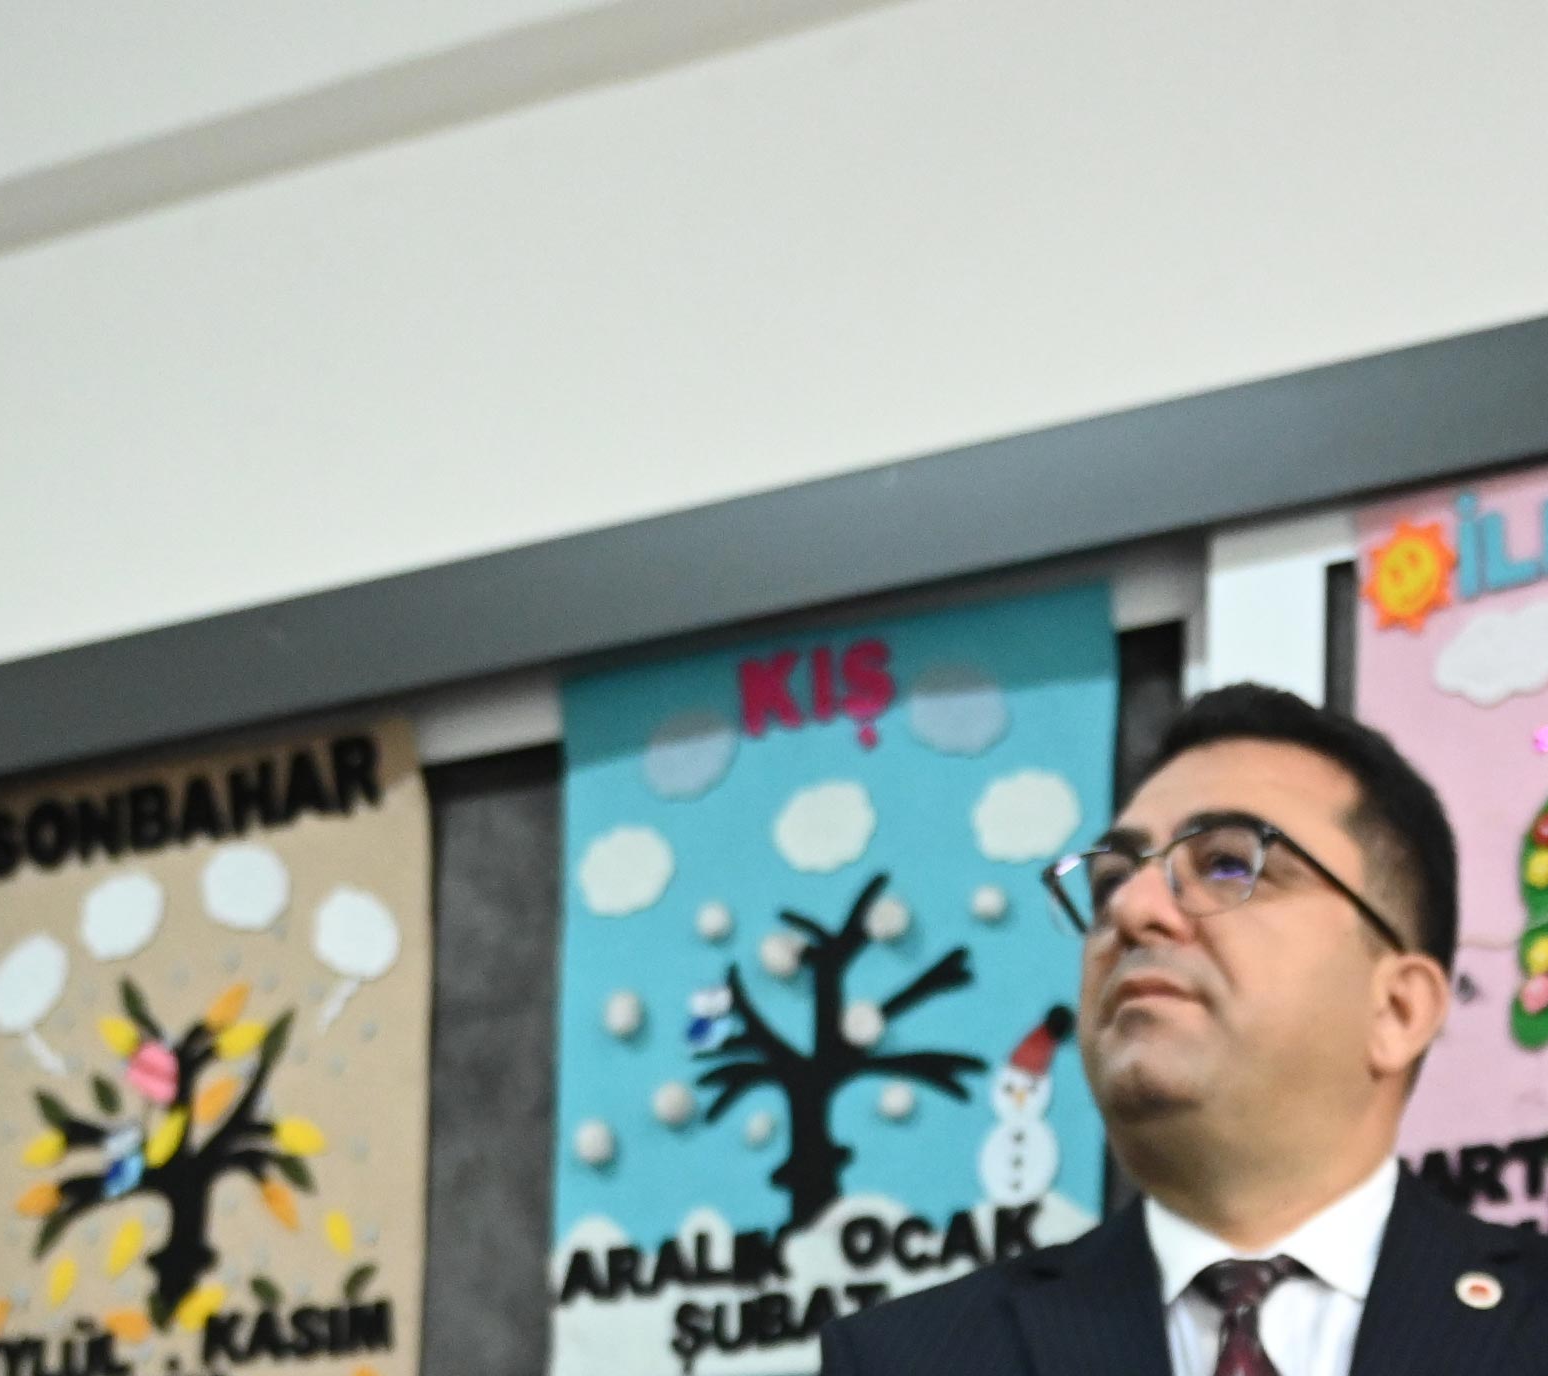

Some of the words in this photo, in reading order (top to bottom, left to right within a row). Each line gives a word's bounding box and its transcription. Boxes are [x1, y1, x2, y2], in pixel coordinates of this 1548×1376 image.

[736, 638, 896, 749] KIŞ
[559, 1226, 791, 1304] ARALIK
[839, 1201, 1043, 1272] OCAK
[202, 1300, 394, 1366] KASIM
